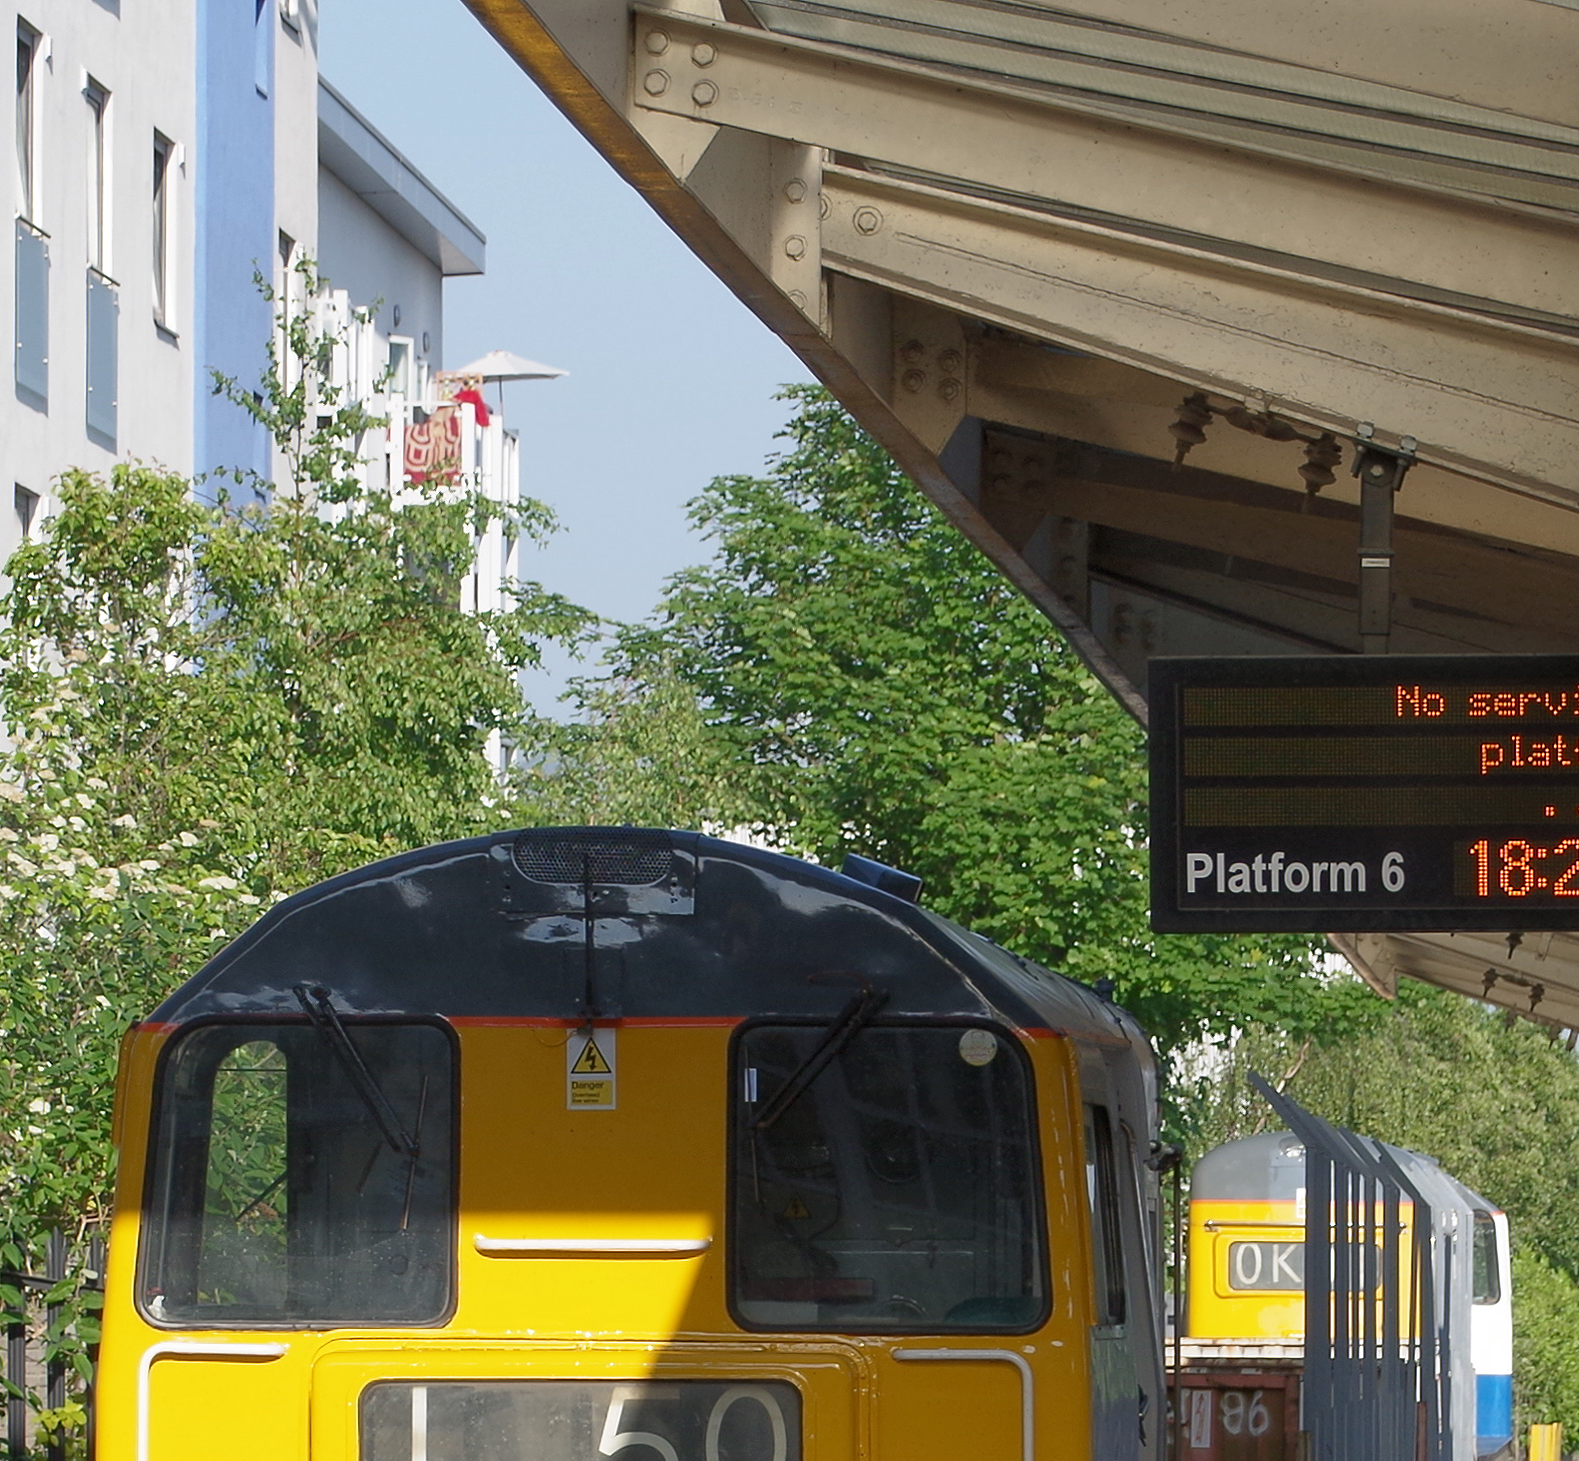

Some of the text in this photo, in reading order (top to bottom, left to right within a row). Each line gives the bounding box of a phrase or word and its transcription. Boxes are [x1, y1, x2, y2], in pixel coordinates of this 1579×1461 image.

[1397, 685, 1445, 717] No
[1186, 851, 1405, 893] Platform 6
[572, 1081, 604, 1090] Danger
